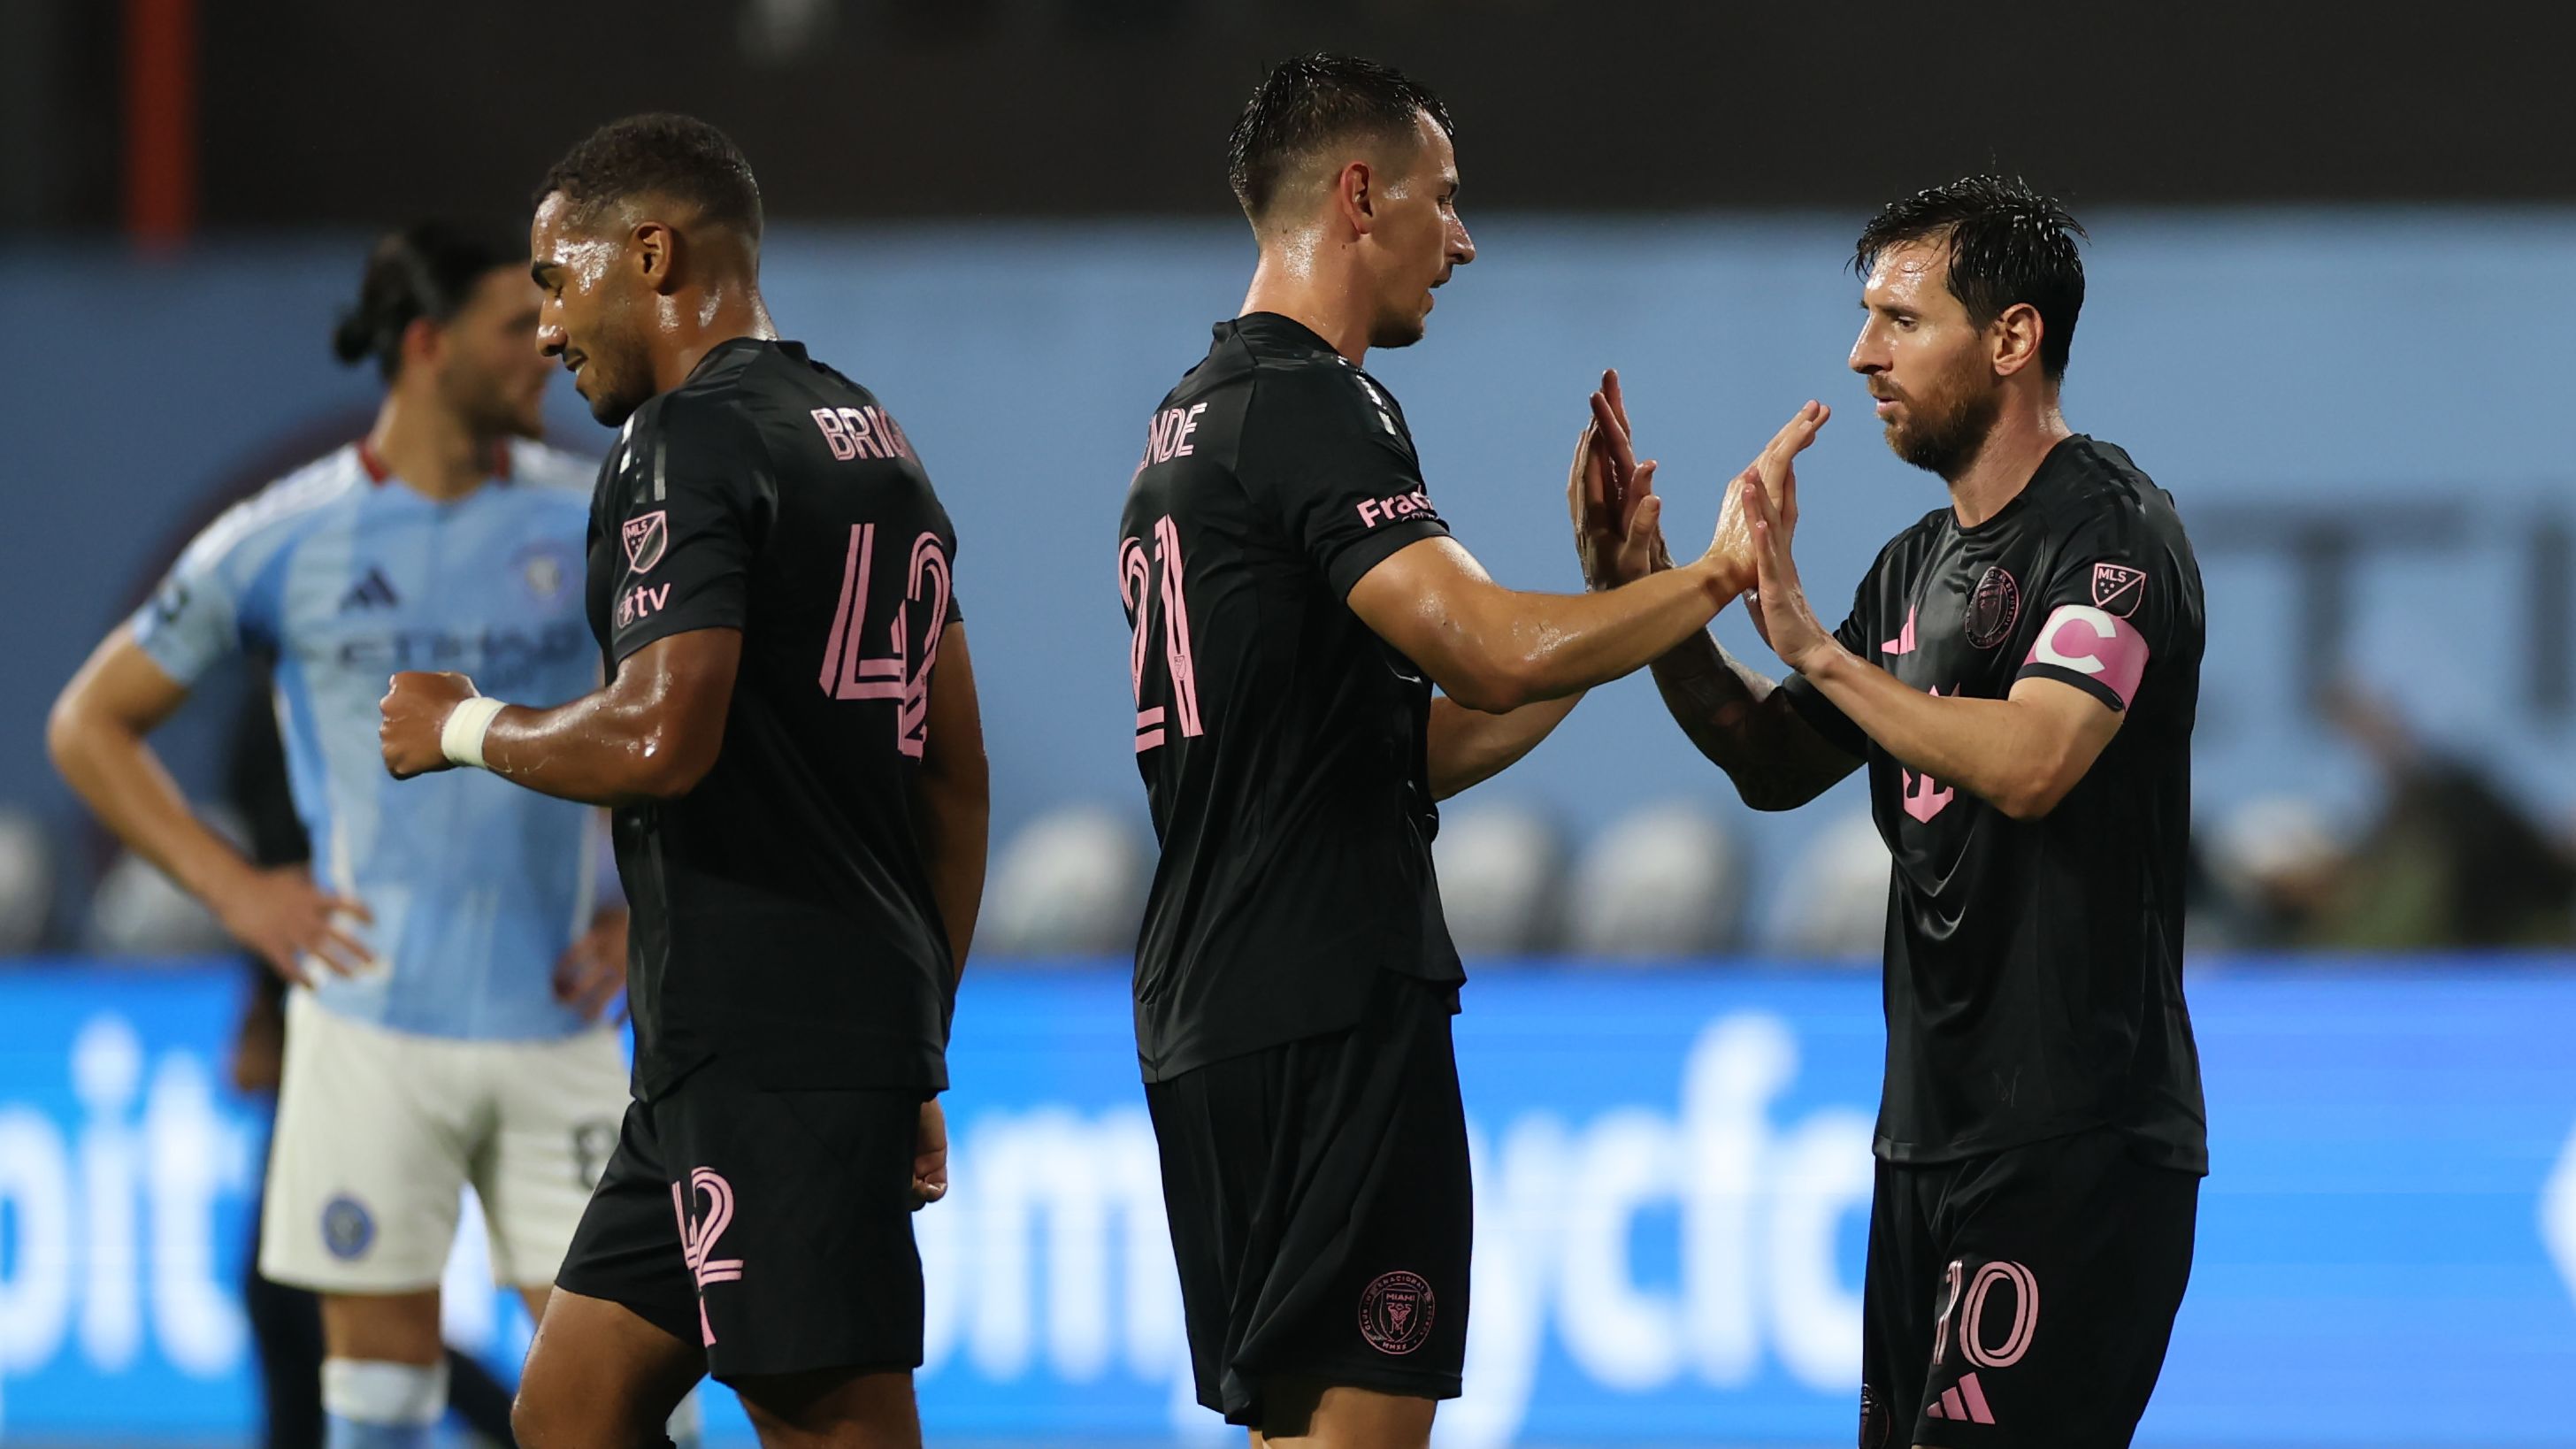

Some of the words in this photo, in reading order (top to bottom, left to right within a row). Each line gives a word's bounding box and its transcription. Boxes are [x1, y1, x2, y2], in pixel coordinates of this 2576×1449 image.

[625, 520, 648, 538] MLS
[2097, 567, 2127, 583] MLS
[1118, 513, 1204, 754] 21
[2035, 604, 2117, 674] C
[1385, 1292, 1416, 1301] MIAMI
[1932, 1259, 2039, 1368] 10
